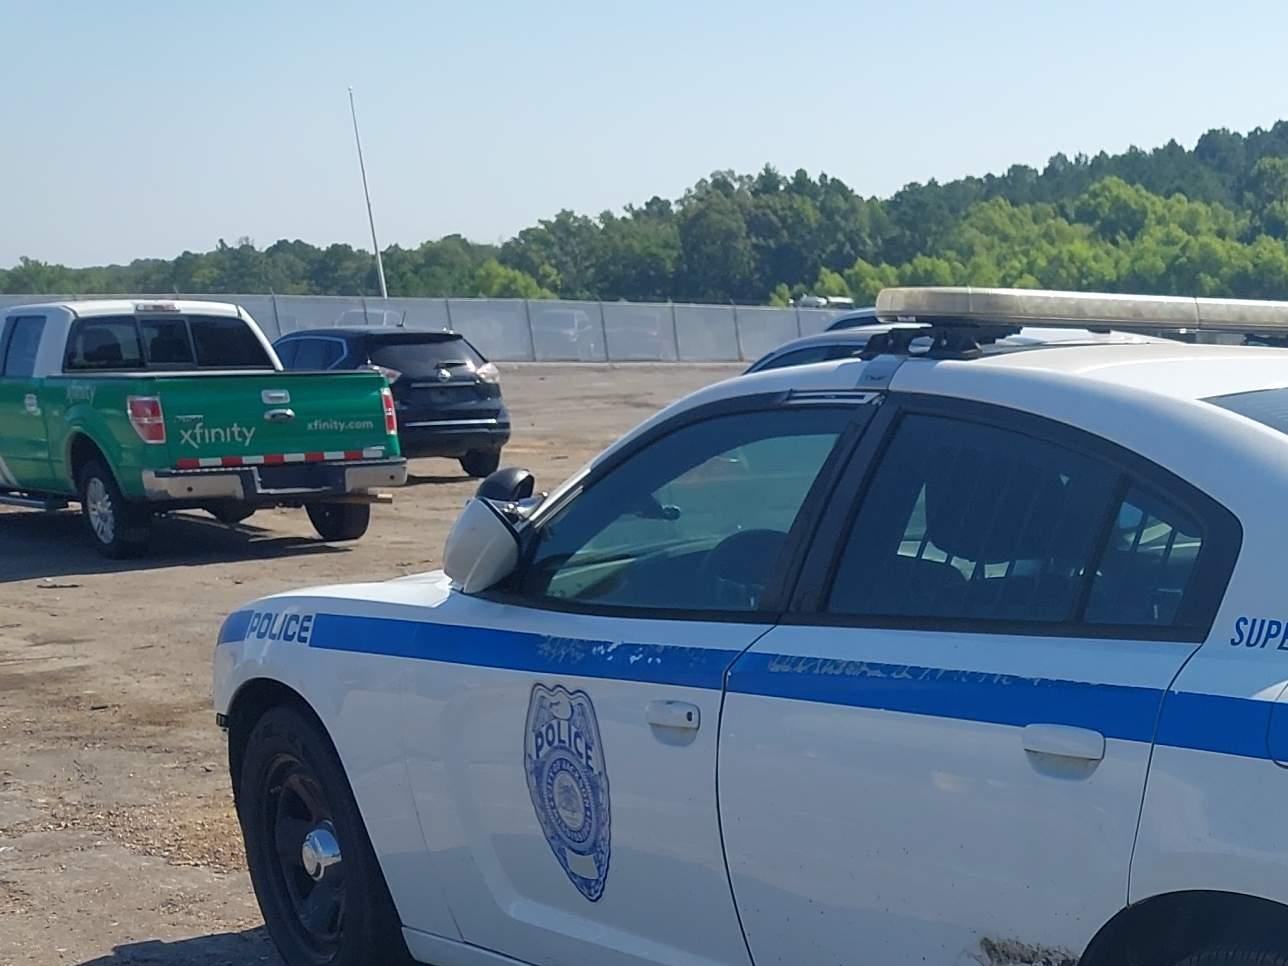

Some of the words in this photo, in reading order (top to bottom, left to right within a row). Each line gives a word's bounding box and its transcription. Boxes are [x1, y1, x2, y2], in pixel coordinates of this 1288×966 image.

[180, 423, 256, 449] xfinity
[306, 419, 374, 431] xfinity.com
[246, 612, 313, 643] POLICE
[535, 719, 594, 772] POLICE
